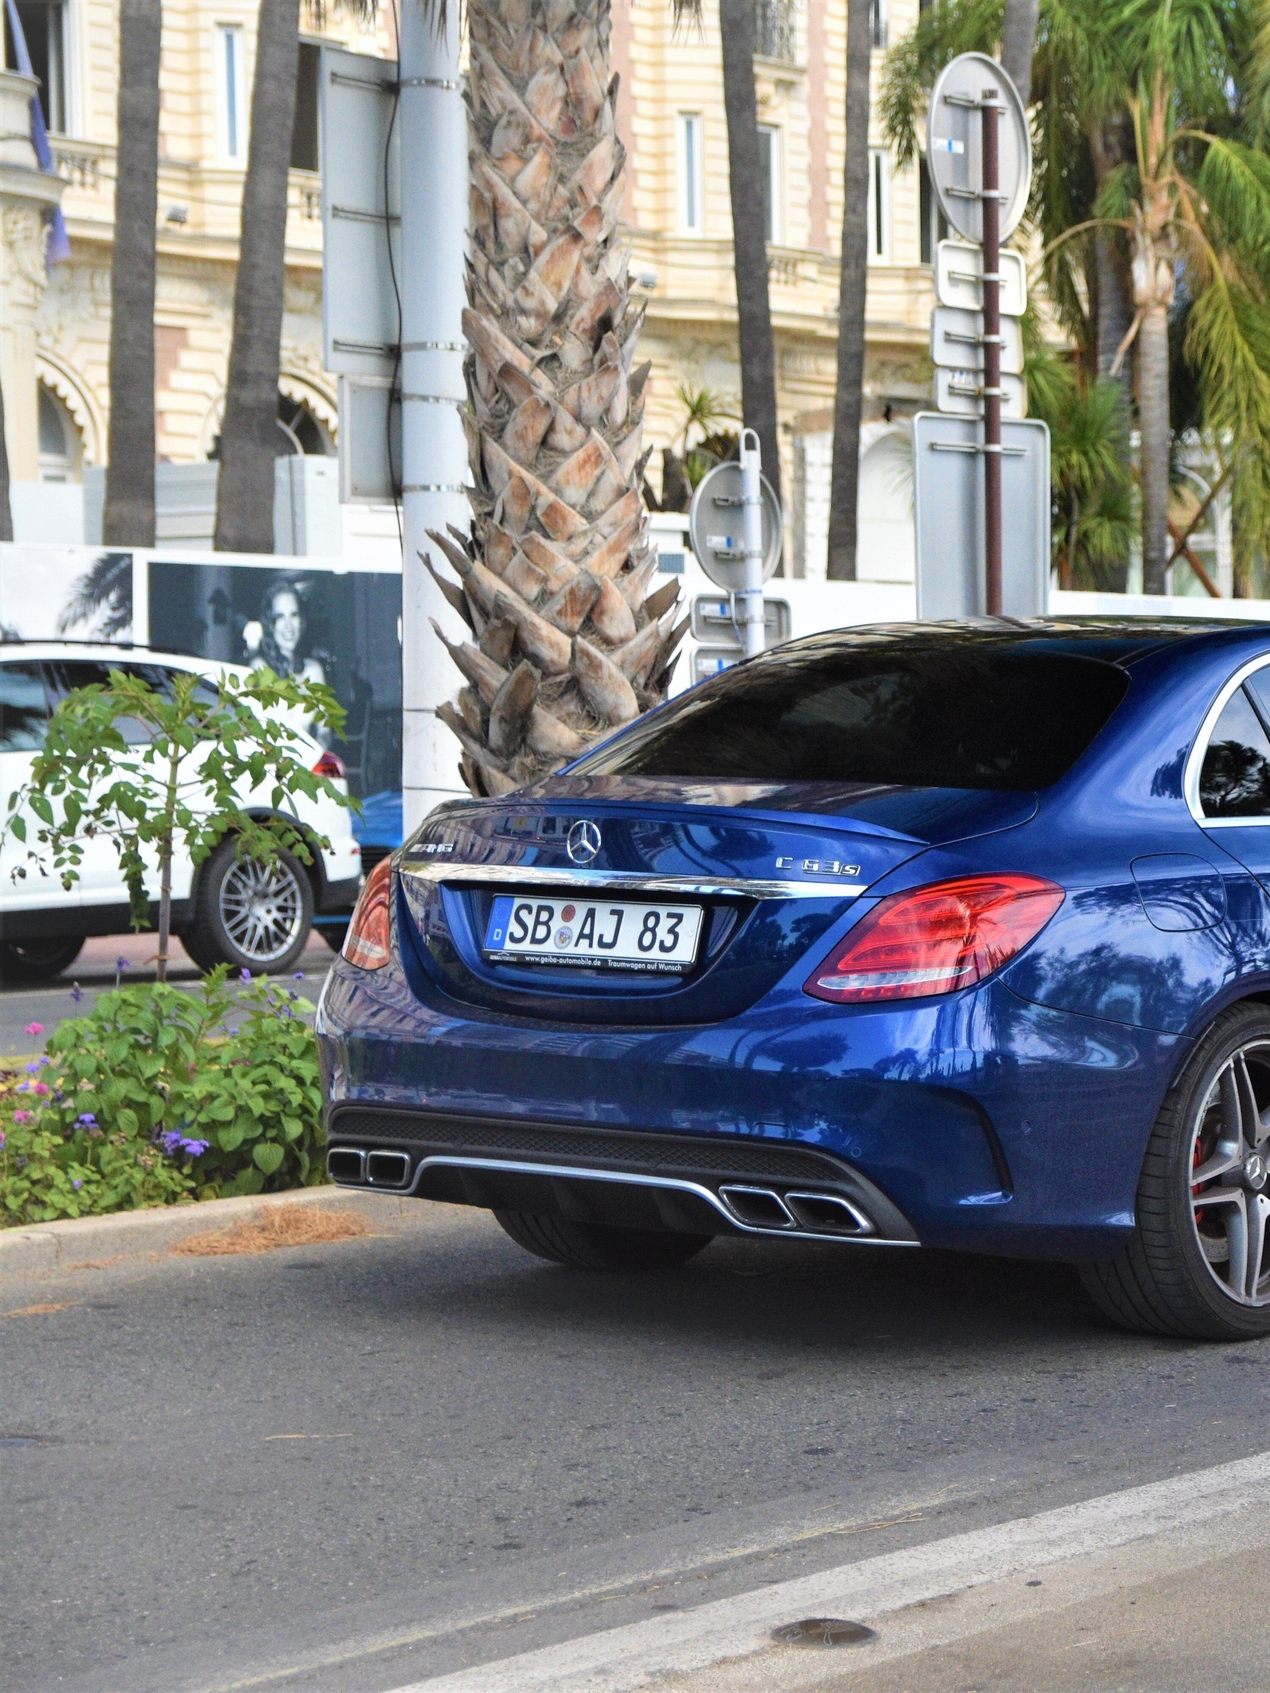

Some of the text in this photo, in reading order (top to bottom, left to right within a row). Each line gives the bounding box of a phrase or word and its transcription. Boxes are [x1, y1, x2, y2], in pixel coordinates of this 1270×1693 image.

[775, 856, 794, 870] C
[493, 928, 502, 941] D
[508, 903, 685, 954] SB AJ 83
[524, 955, 602, 967] www.geiba-automobile.de
[608, 959, 646, 971] Traumwagen
[646, 962, 658, 970] auf
[658, 962, 682, 972] Wunsch
